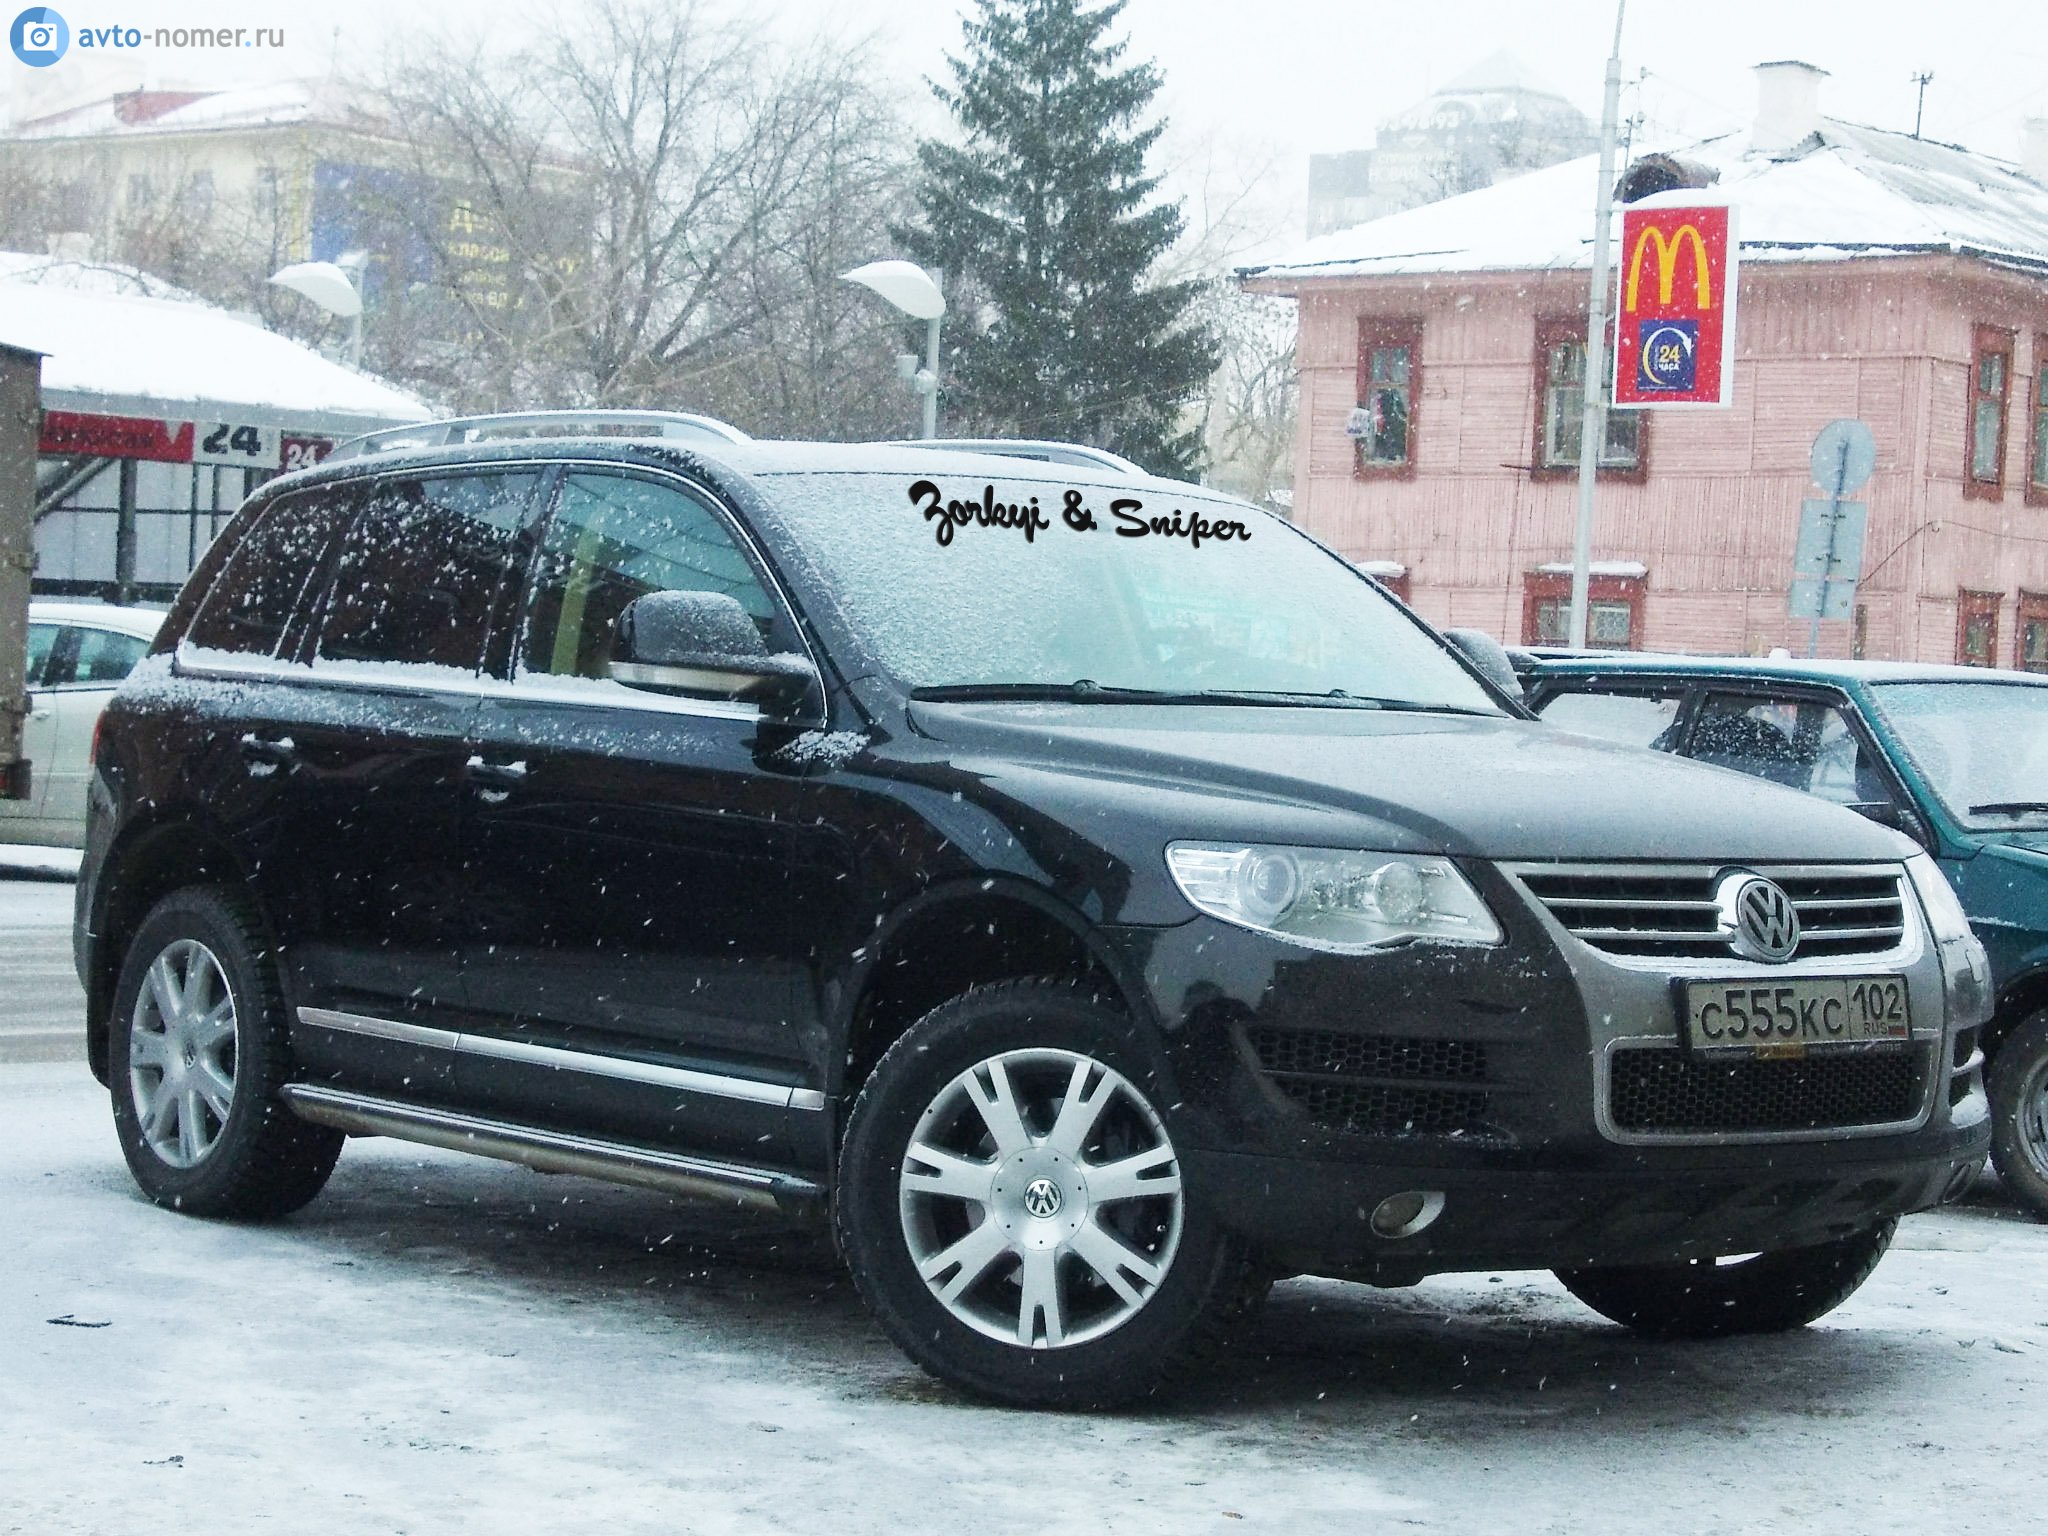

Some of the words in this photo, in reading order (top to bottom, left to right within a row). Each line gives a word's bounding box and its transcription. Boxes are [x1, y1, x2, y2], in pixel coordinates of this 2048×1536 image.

[1660, 344, 1680, 363] 24
[203, 424, 261, 456] 24
[288, 444, 318, 469] 24
[1852, 982, 1902, 1020] 102
[1863, 1021, 1887, 1035] RUS
